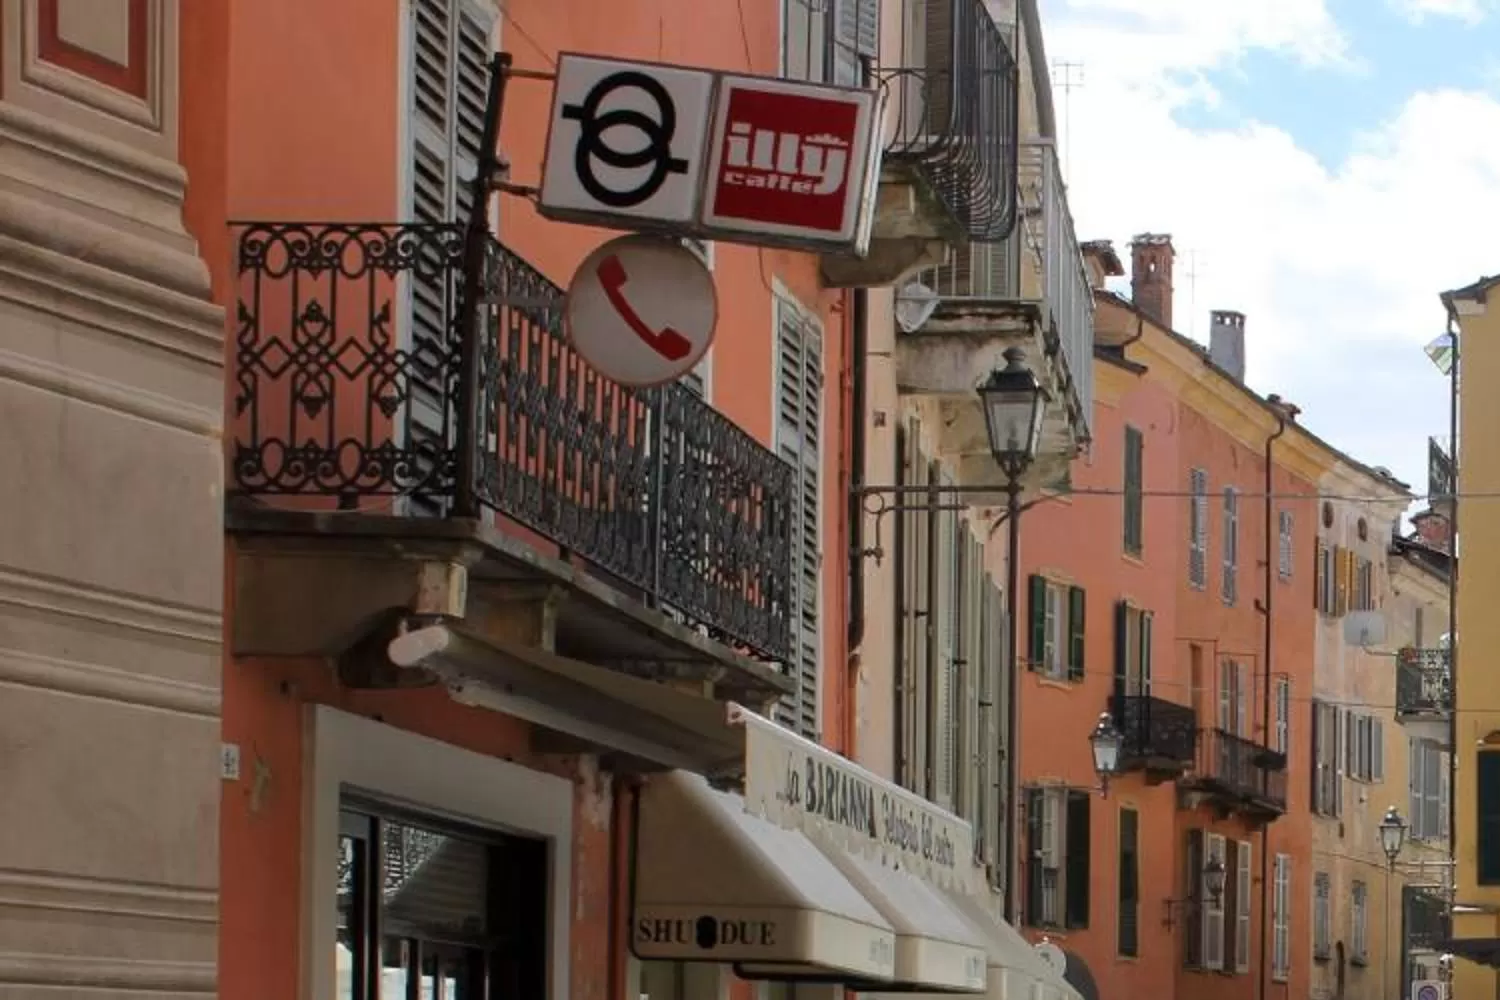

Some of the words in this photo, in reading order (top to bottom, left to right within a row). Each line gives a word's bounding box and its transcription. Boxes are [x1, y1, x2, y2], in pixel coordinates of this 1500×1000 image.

[727, 121, 848, 195] illy
[637, 918, 693, 943] SHU
[720, 920, 776, 946] DUE
